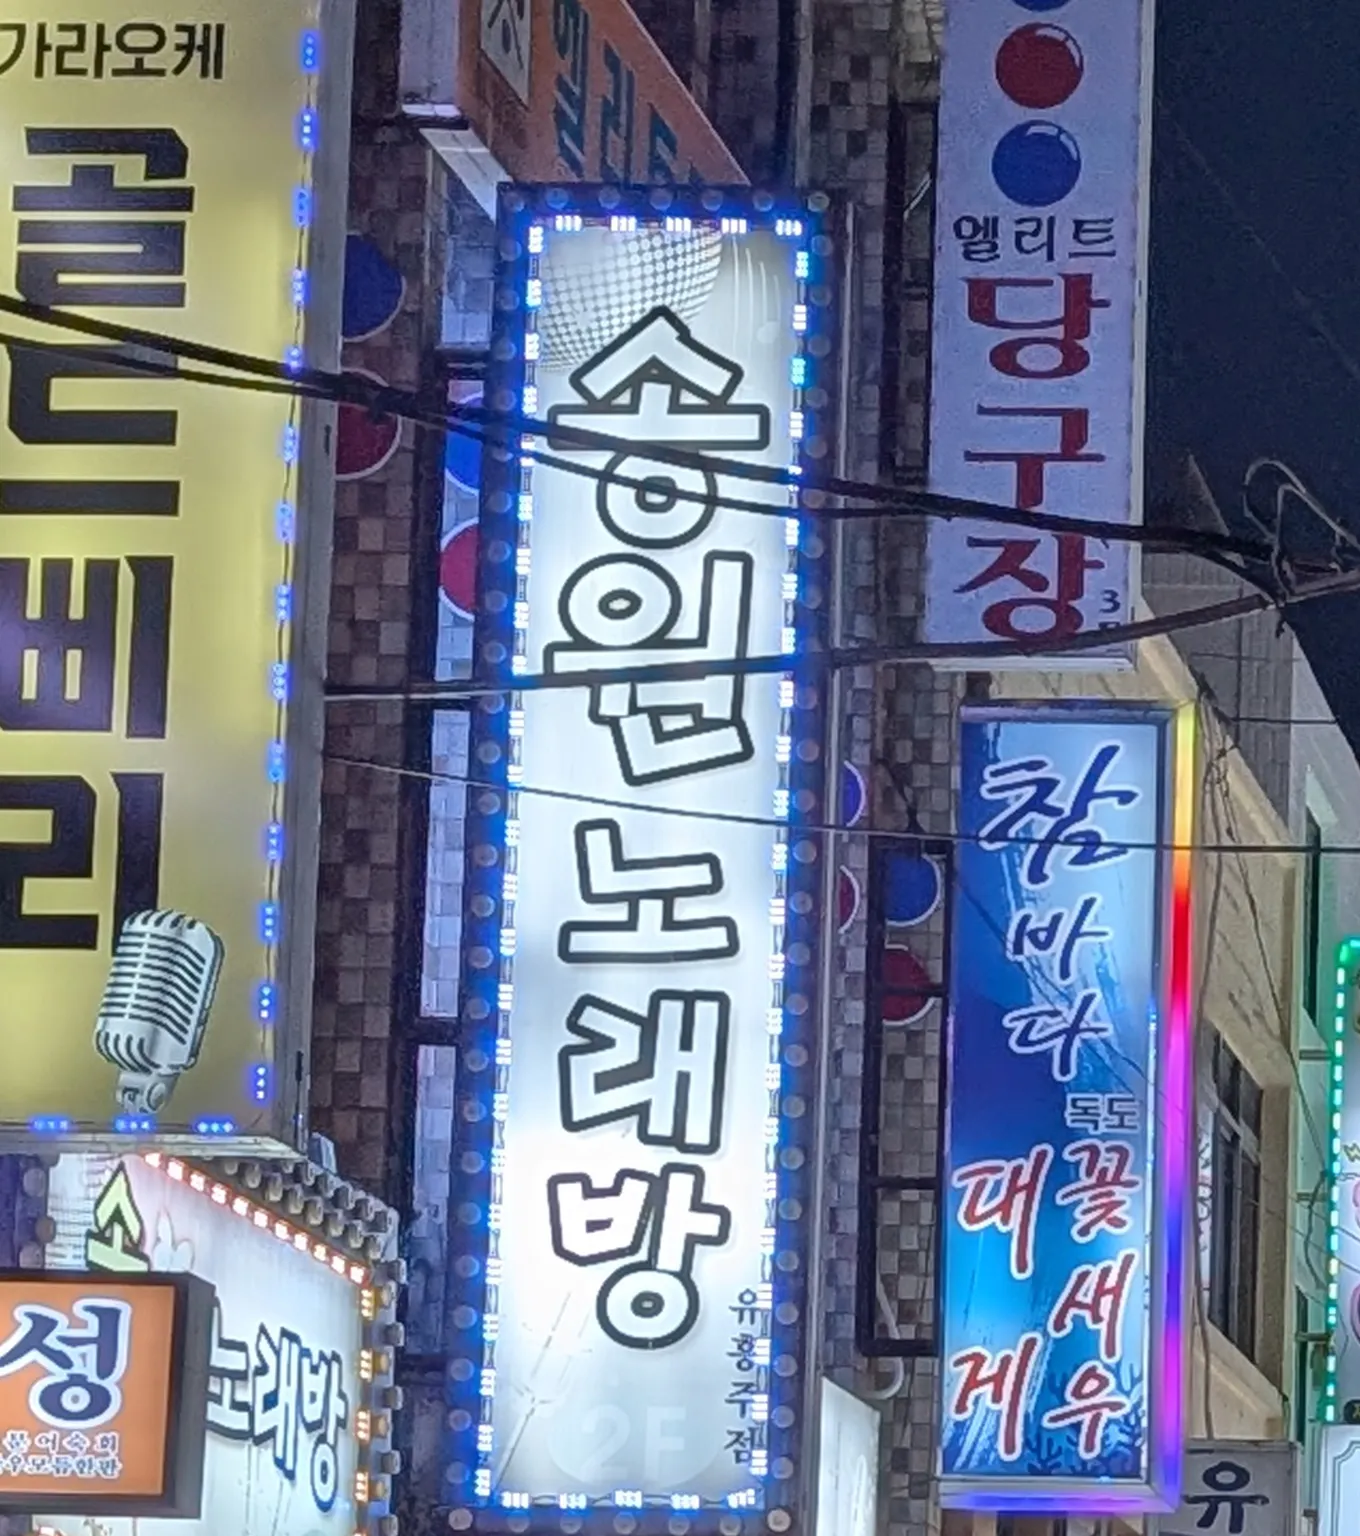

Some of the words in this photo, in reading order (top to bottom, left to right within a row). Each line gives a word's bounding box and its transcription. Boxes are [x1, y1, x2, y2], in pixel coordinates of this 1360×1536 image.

[0, 22, 227, 80] 가라오케
[952, 214, 1118, 263] 엘리트
[953, 273, 1112, 648] 당구장
[978, 743, 1140, 1081] 참바다
[1065, 1094, 1140, 1133] 독도
[951, 1144, 1052, 1462] 대게
[1044, 1143, 1141, 1459] 꽃새우
